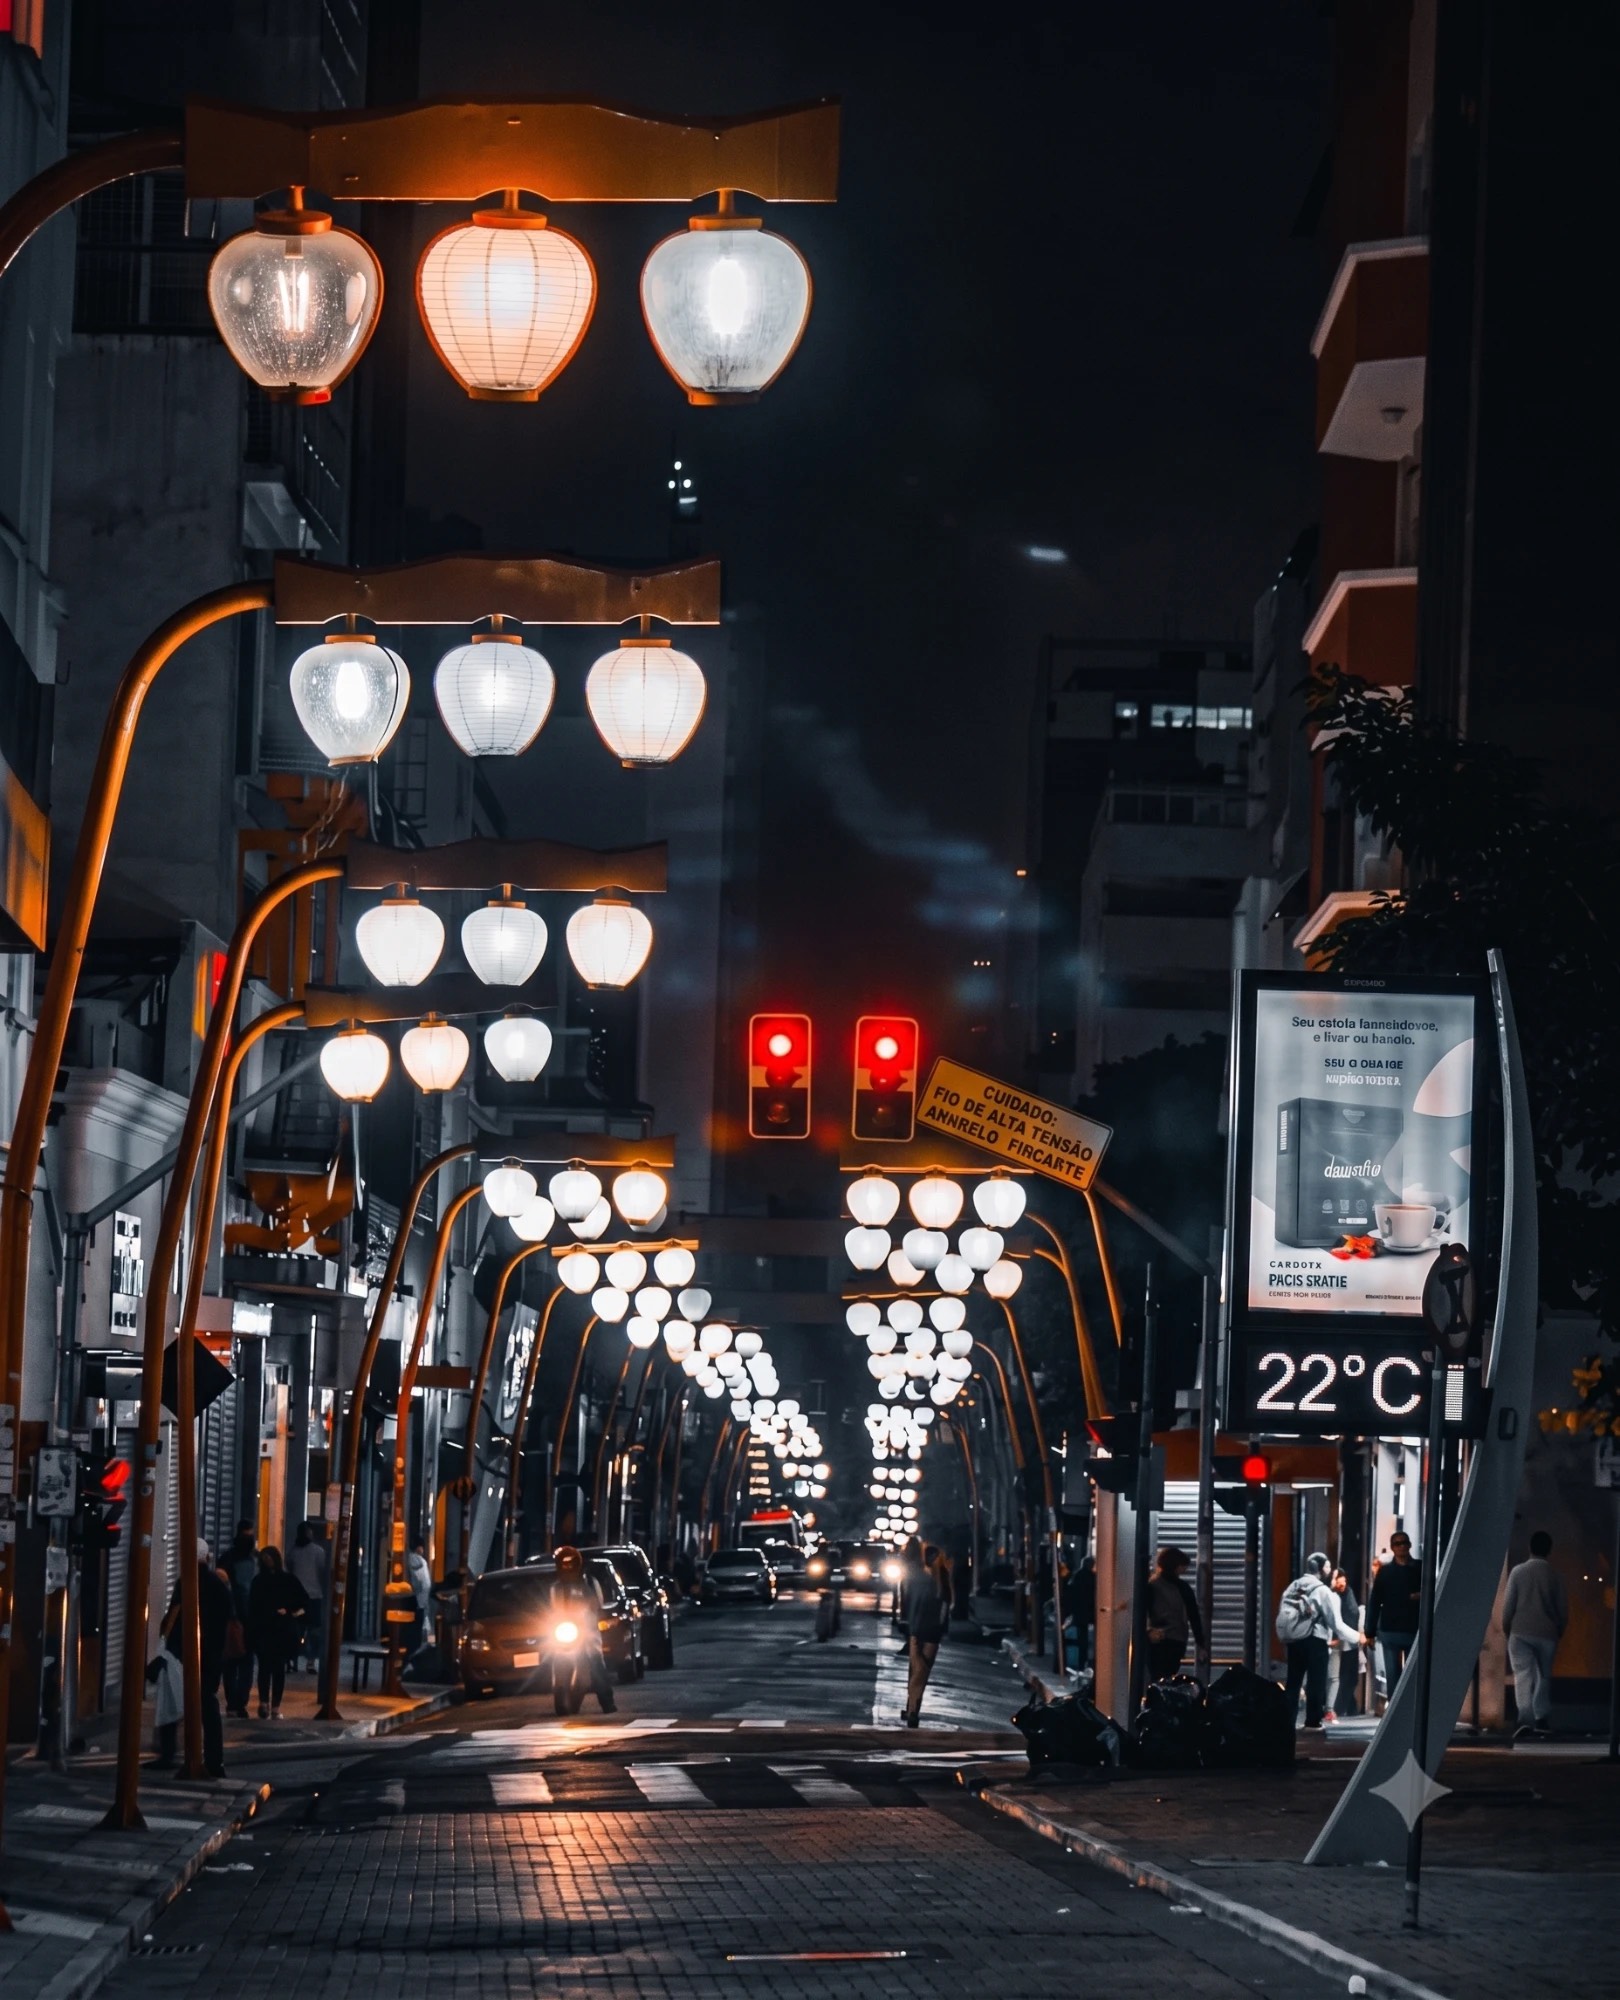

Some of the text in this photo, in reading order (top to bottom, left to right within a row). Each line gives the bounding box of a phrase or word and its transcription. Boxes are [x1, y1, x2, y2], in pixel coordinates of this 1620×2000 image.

[1292, 1016, 1315, 1028] Seu
[1313, 1034, 1321, 1042] e
[1324, 1031, 1350, 1043] livar
[1353, 1034, 1368, 1044] ou
[983, 1085, 1058, 1127] CUIDADO:
[933, 1086, 1093, 1162] FIO DE ALTA TENSÃO
[1269, 1261, 1322, 1269] CARDOTX
[1269, 1273, 1348, 1288] PACIS SRATIE
[1256, 1352, 1421, 1415] 22°C
